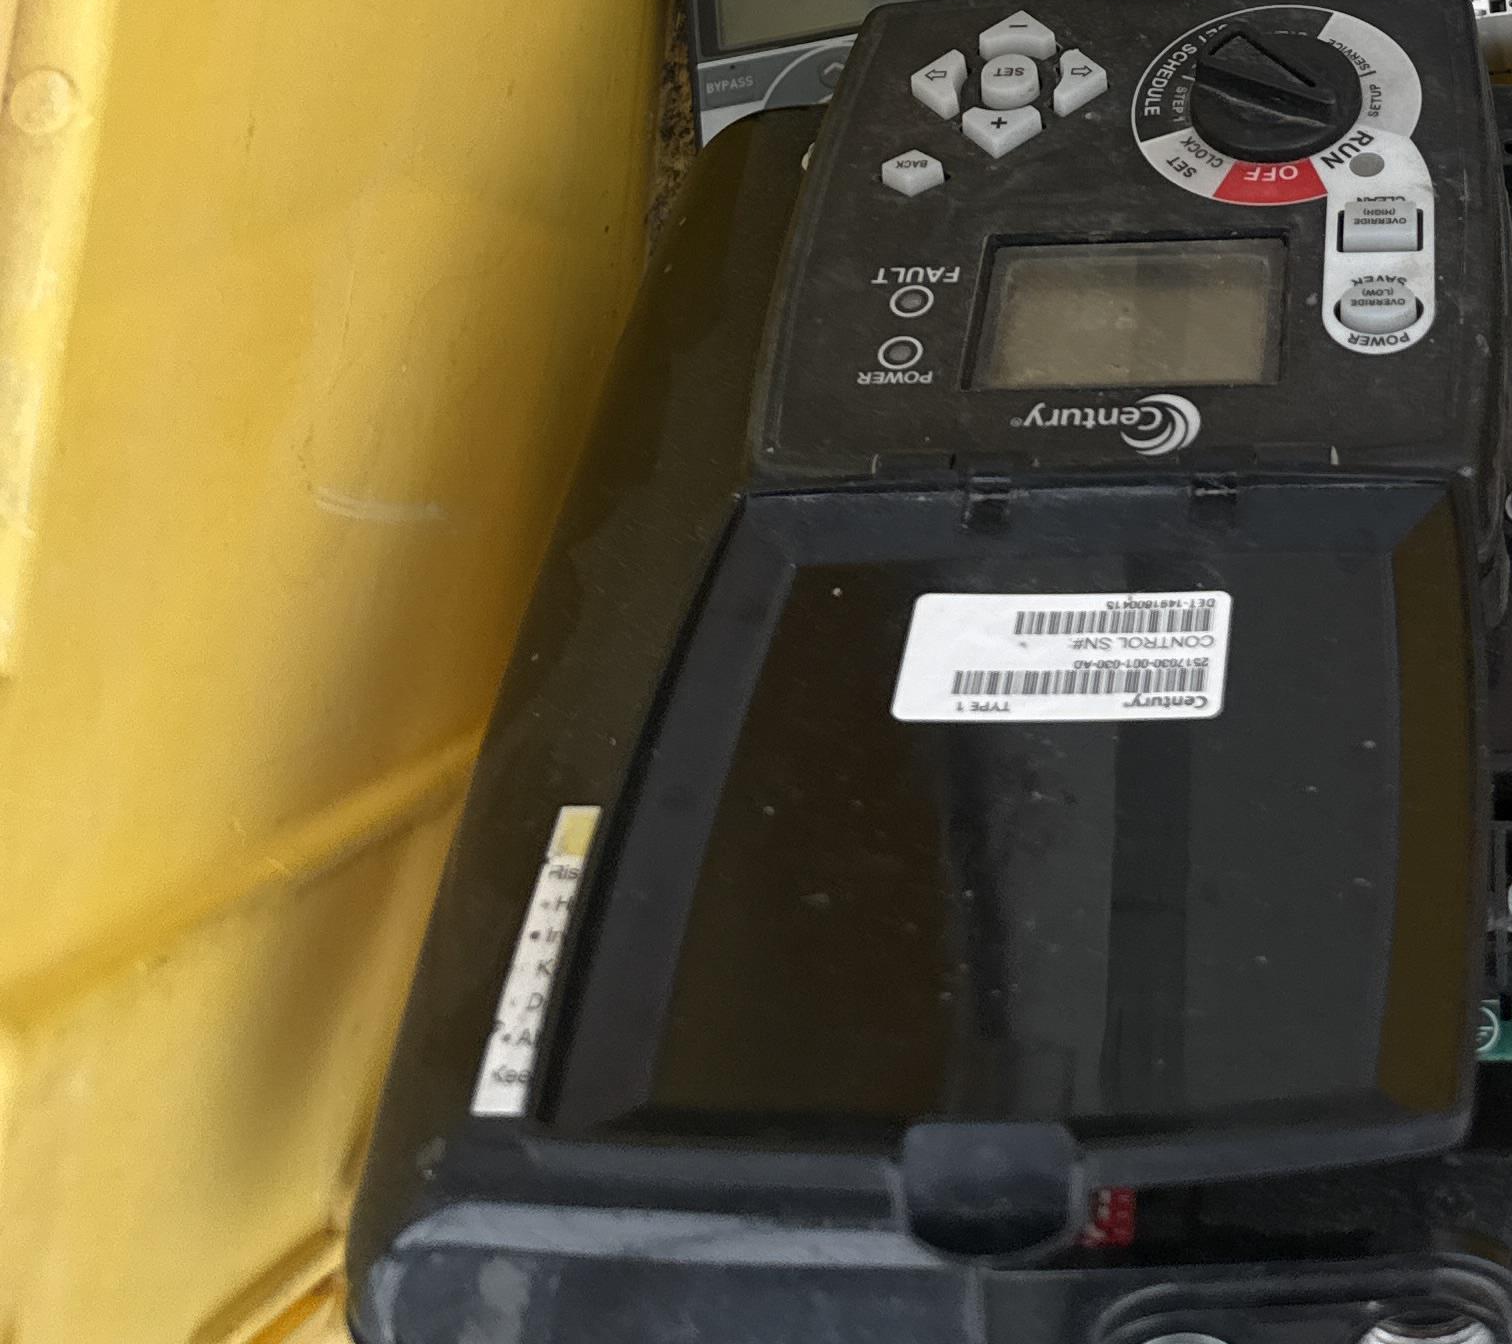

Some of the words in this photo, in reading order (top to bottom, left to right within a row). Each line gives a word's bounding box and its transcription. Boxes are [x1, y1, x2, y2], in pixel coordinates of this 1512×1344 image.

[1325, 38, 1370, 71] SERVICE
[992, 66, 1024, 76] SET
[1143, 42, 1197, 116] SCHEDULE
[704, 74, 755, 94] BYPASS
[1171, 85, 1185, 113] STEP
[1368, 83, 1381, 117] SETUP
[1179, 135, 1223, 168] CLOCK
[1319, 130, 1374, 169] RUN
[895, 159, 928, 170] BACK
[1165, 154, 1196, 178] SET
[1243, 164, 1298, 181] OFF
[1363, 207, 1395, 215] (HIGH)
[871, 267, 960, 284] FAULT
[1361, 288, 1393, 296] (LOW)
[1350, 298, 1405, 306] OVERRIDE
[1347, 331, 1410, 346] POWER
[857, 370, 934, 384] POWER
[1023, 402, 1163, 431] Century
[1117, 633, 1214, 649] CONTROL
[970, 701, 1010, 713] TYPE
[1130, 692, 1208, 709] Century
[549, 863, 580, 880] Ris
